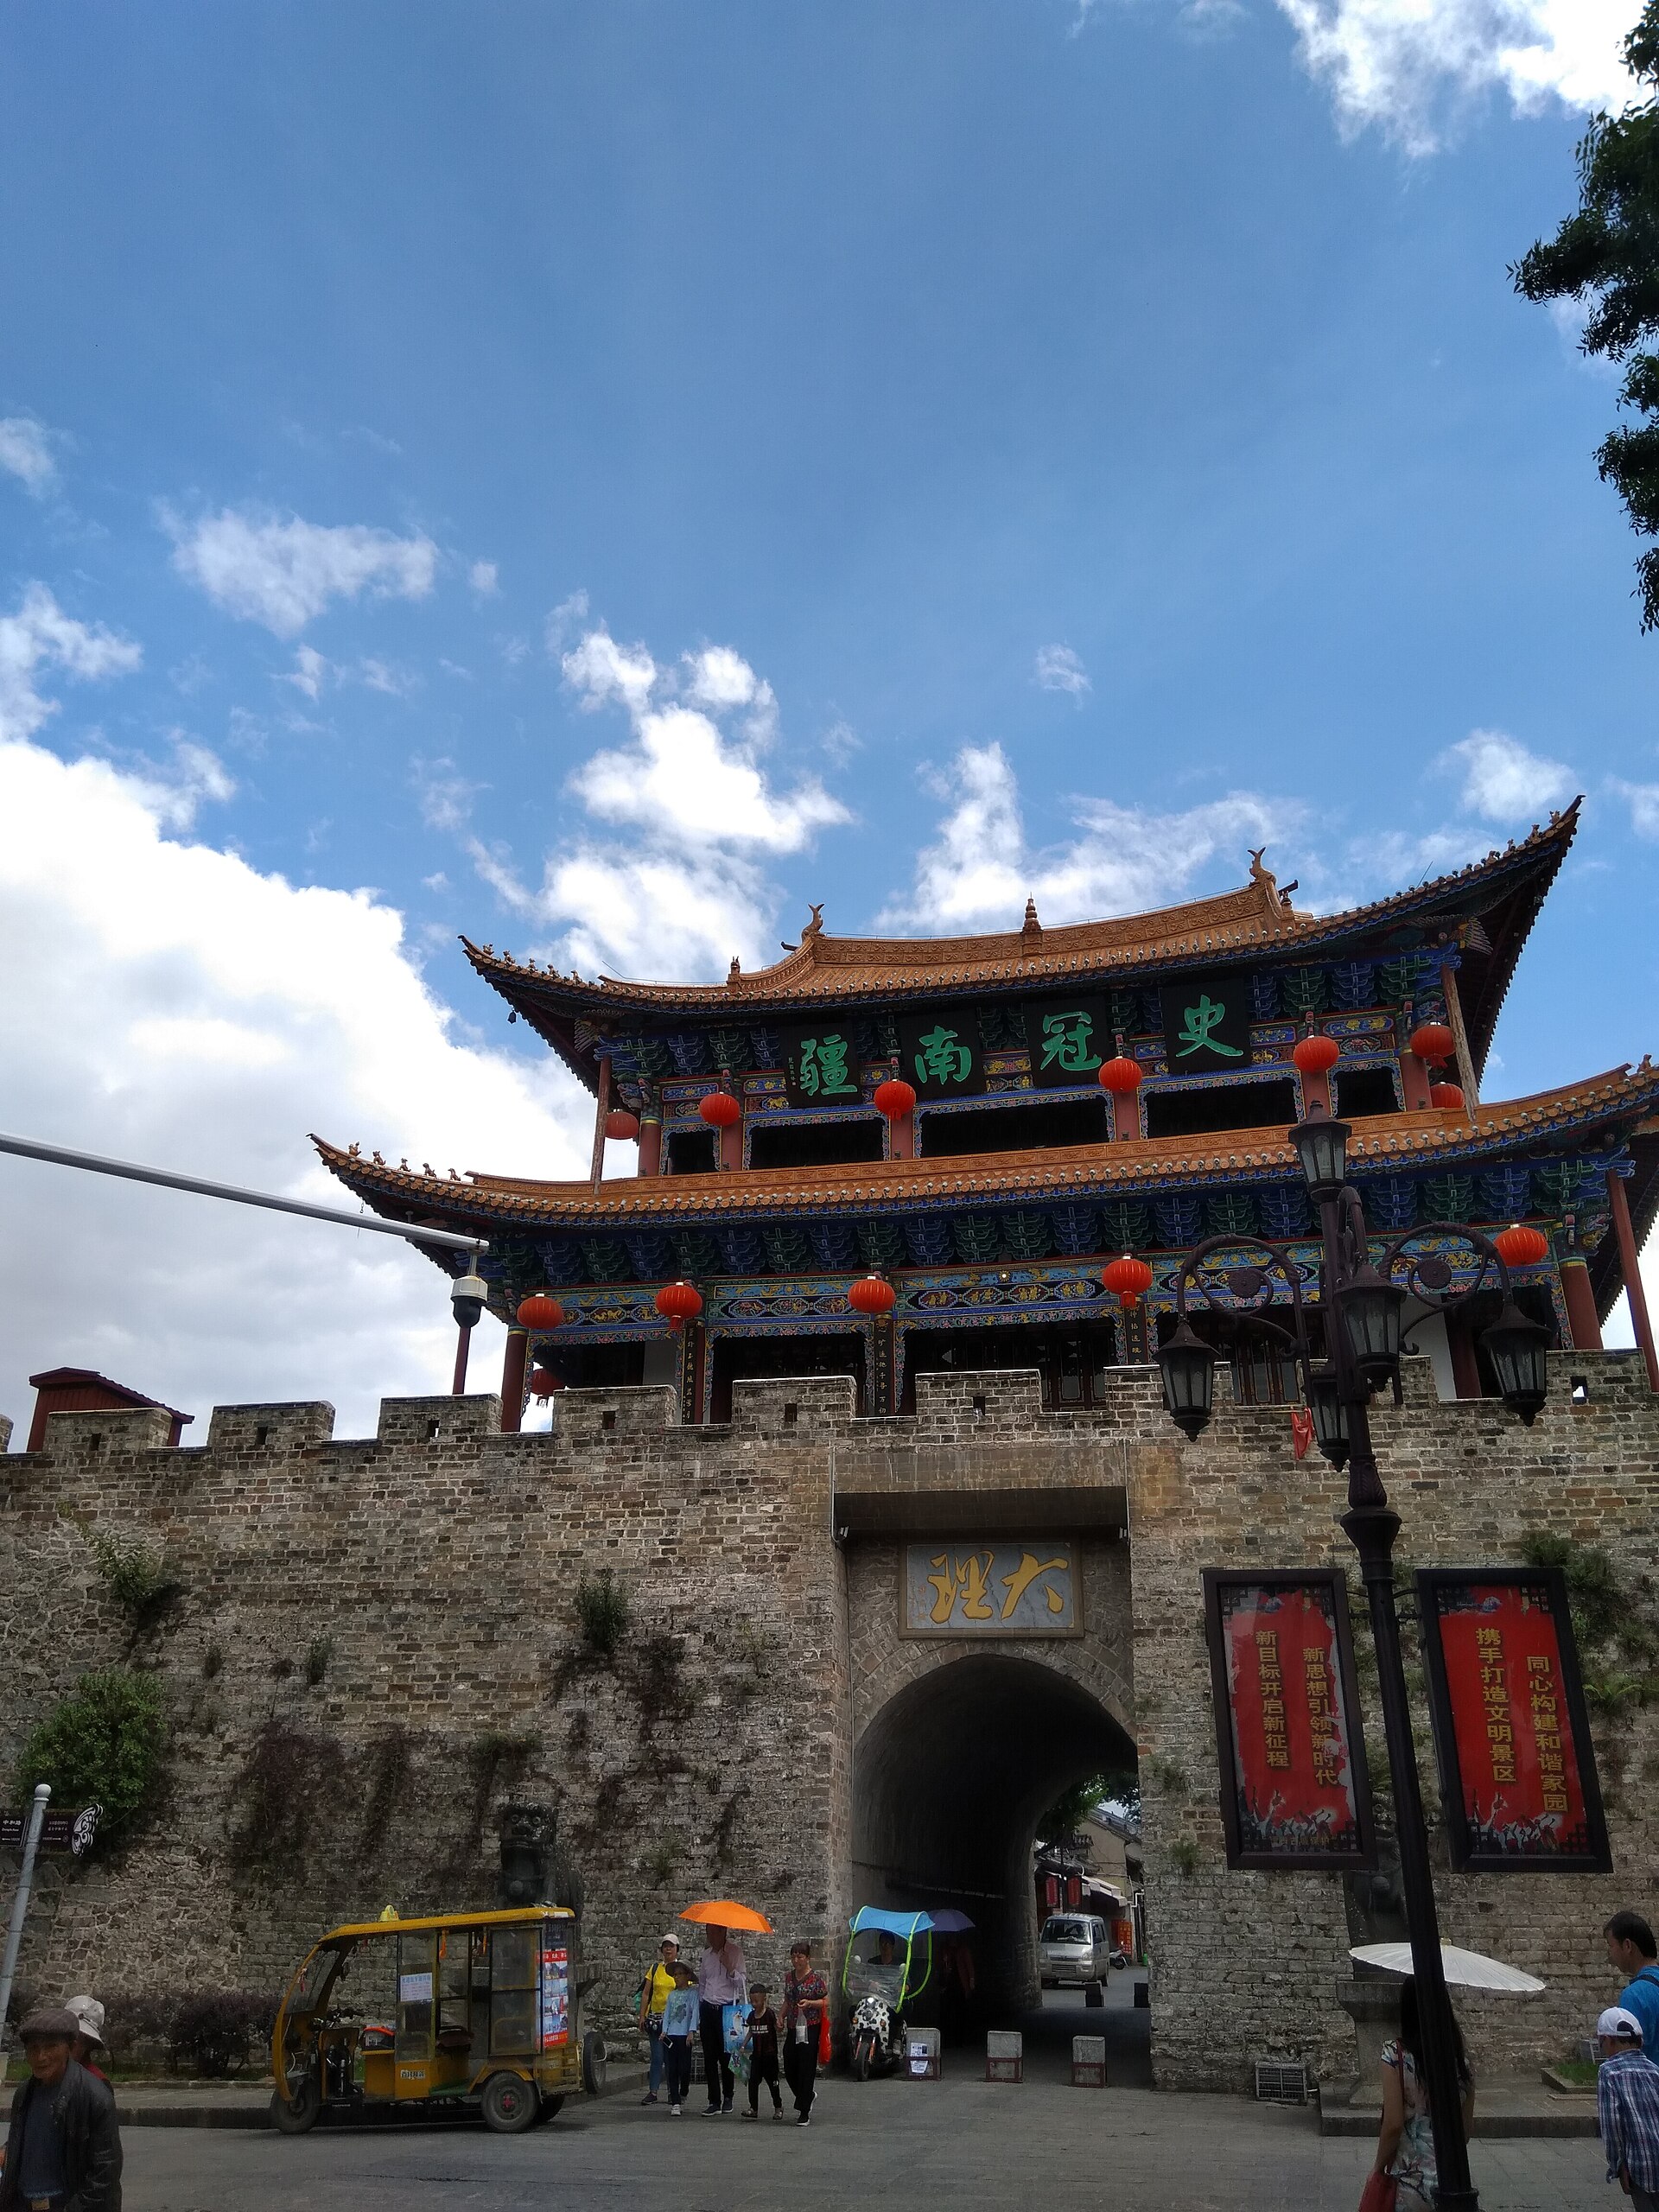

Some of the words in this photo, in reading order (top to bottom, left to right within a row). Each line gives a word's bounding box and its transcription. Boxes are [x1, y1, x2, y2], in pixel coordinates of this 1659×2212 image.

[1255, 1629, 1290, 1768] 新目标开启新征程
[1302, 1646, 1338, 1786] 新思想引领新时代
[1475, 1627, 1516, 1783] 携手打造文明景区
[1526, 1655, 1569, 1814] 同心构建和谐家园
